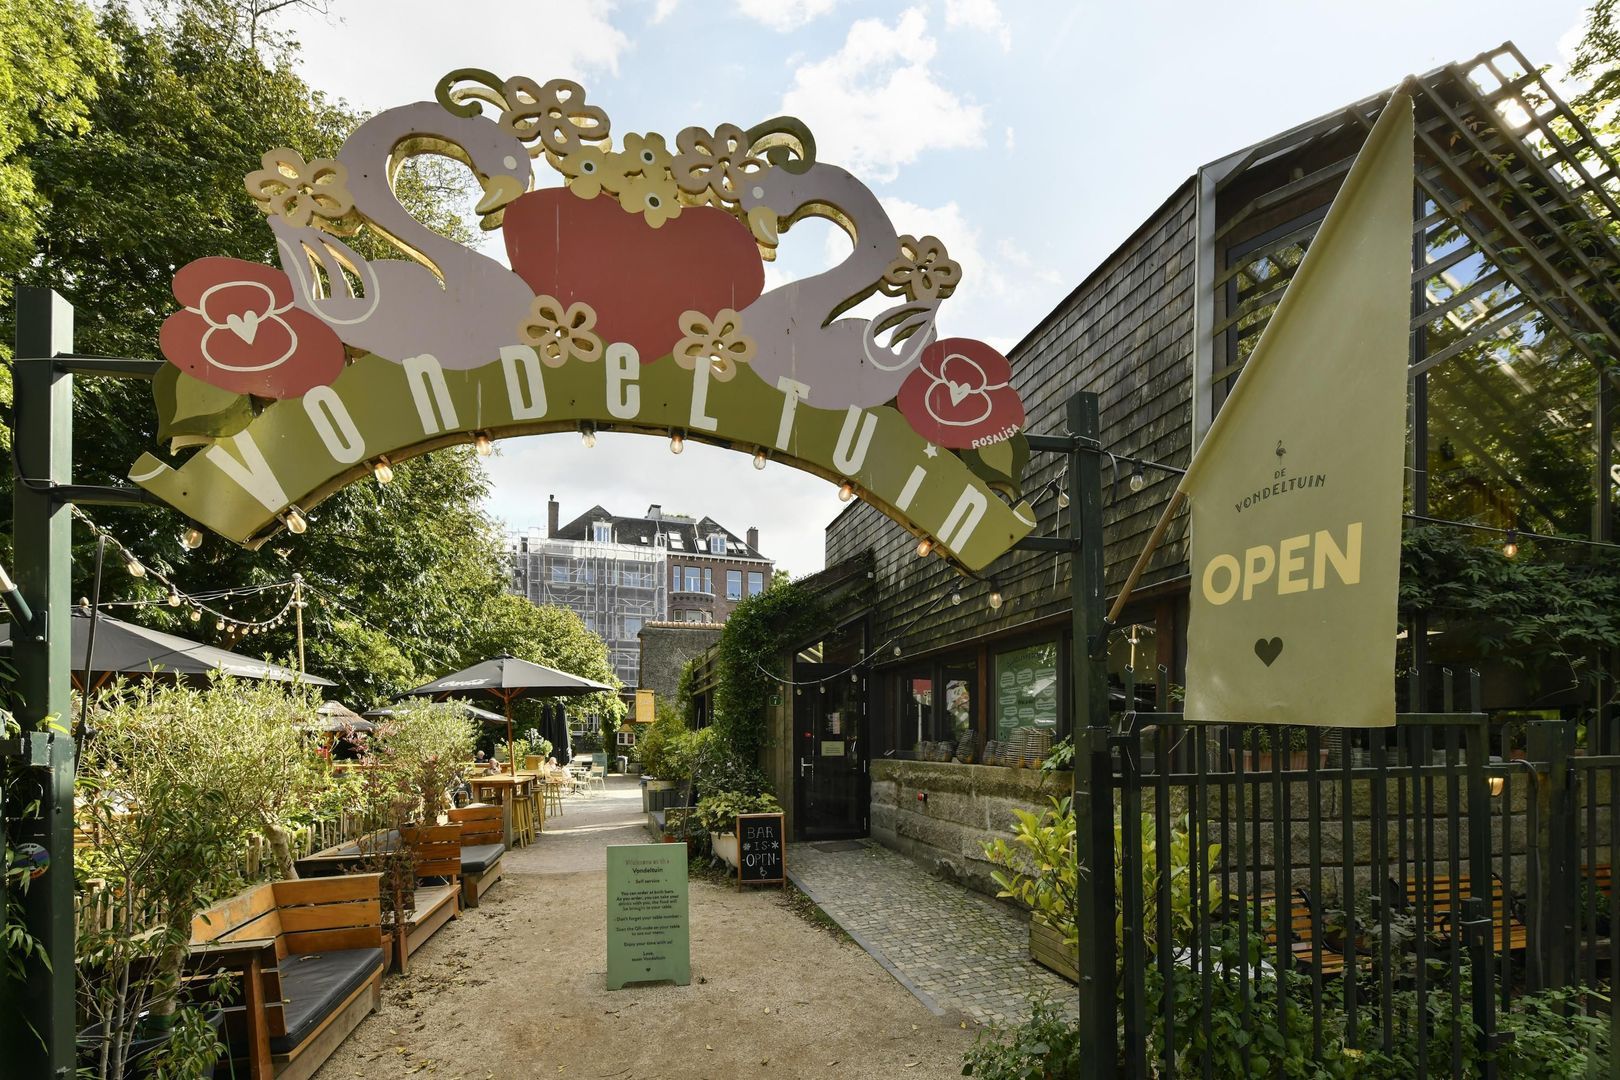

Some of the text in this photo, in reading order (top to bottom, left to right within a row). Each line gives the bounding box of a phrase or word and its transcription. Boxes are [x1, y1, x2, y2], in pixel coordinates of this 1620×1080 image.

[1274, 467, 1287, 480] DE
[1234, 474, 1326, 513] VONDELTUIN
[1202, 522, 1362, 606] OPEN
[773, 696, 778, 705] 7
[747, 826, 774, 839] BAR
[753, 840, 768, 851] IS
